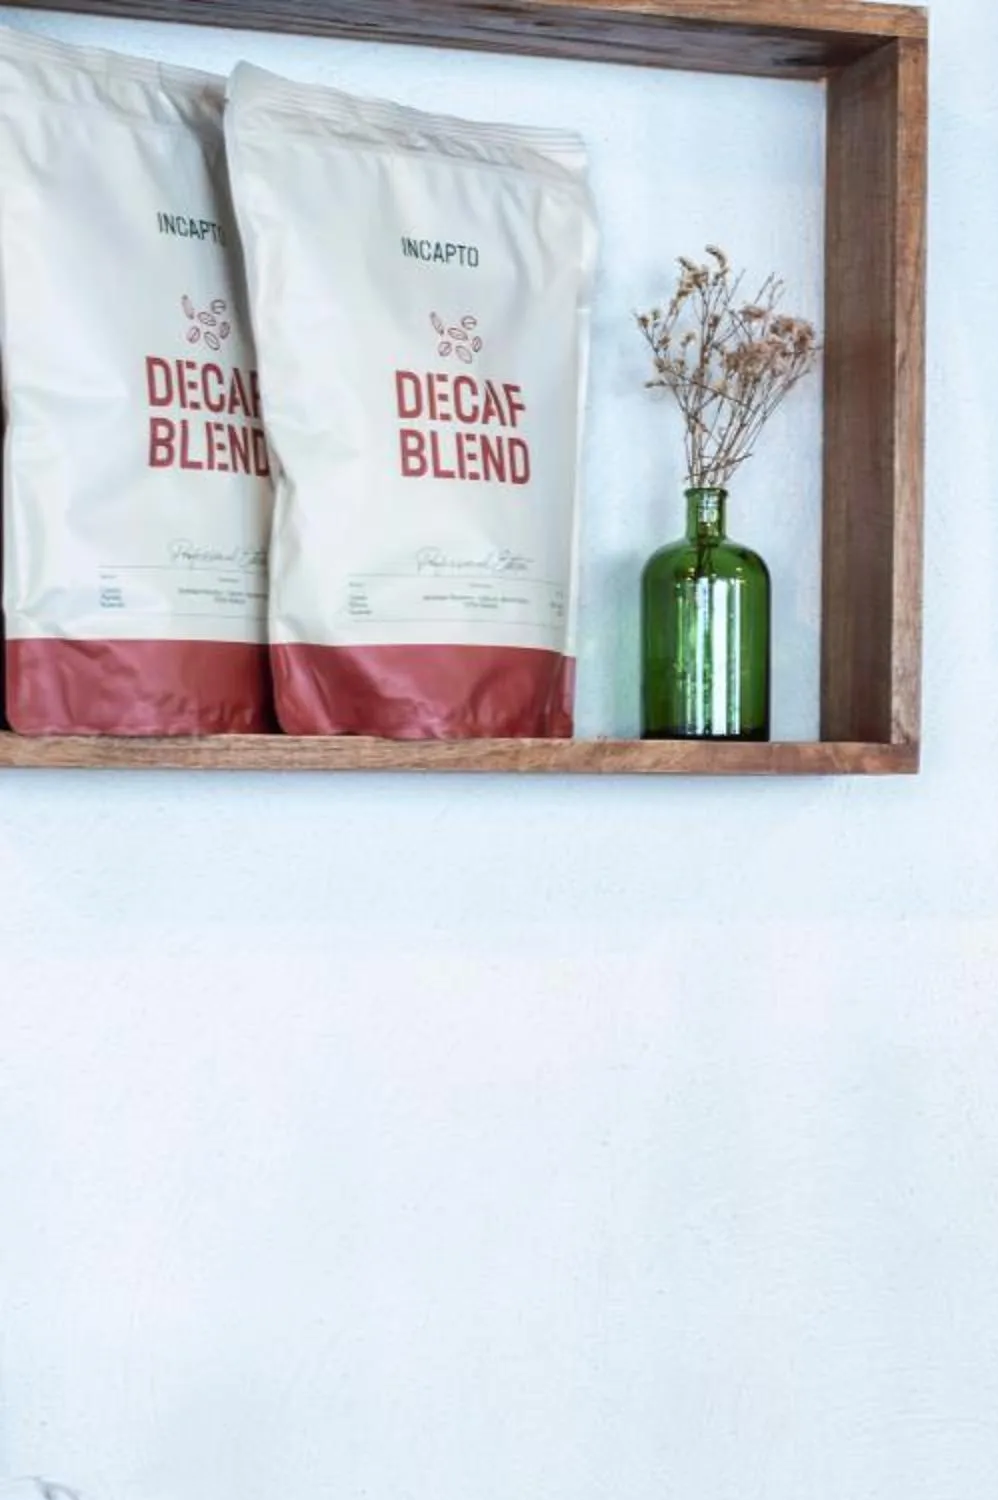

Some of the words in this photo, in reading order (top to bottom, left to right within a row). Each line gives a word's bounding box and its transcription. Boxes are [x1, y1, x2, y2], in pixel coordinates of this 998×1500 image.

[401, 237, 479, 267] INCAPTO
[395, 370, 525, 427] DECAF
[148, 417, 270, 477] BLEND
[400, 428, 530, 484] BLEND
